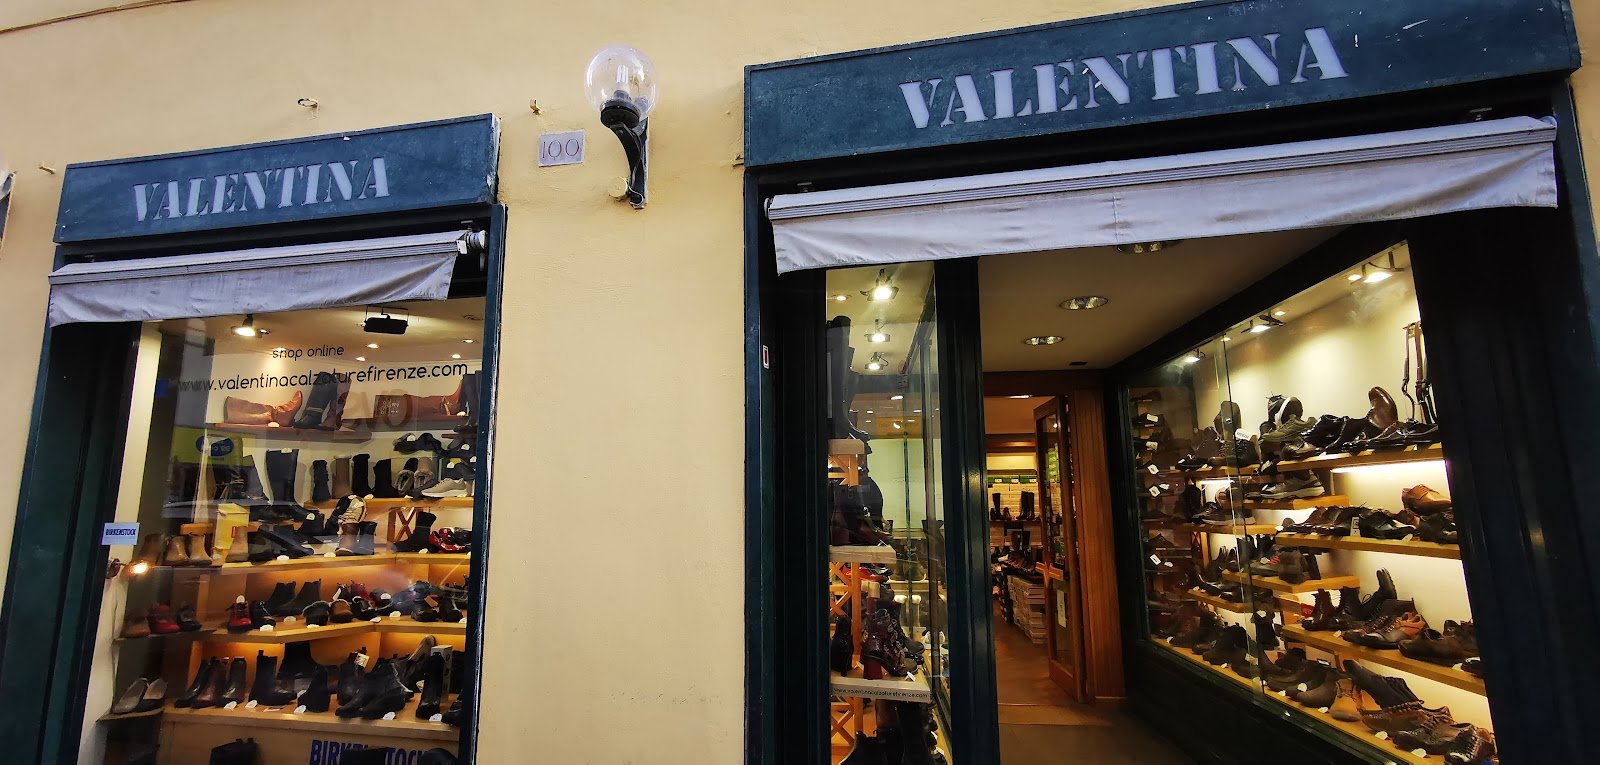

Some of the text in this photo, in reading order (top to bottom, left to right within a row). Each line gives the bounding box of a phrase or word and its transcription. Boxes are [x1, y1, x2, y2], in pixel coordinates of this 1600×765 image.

[898, 26, 1350, 130] VALENTINA
[542, 139, 580, 159] 100
[133, 157, 391, 222] VALENTINA
[272, 344, 345, 361] shop online
[177, 361, 469, 391] www.valentinacalzaturefirenze.com
